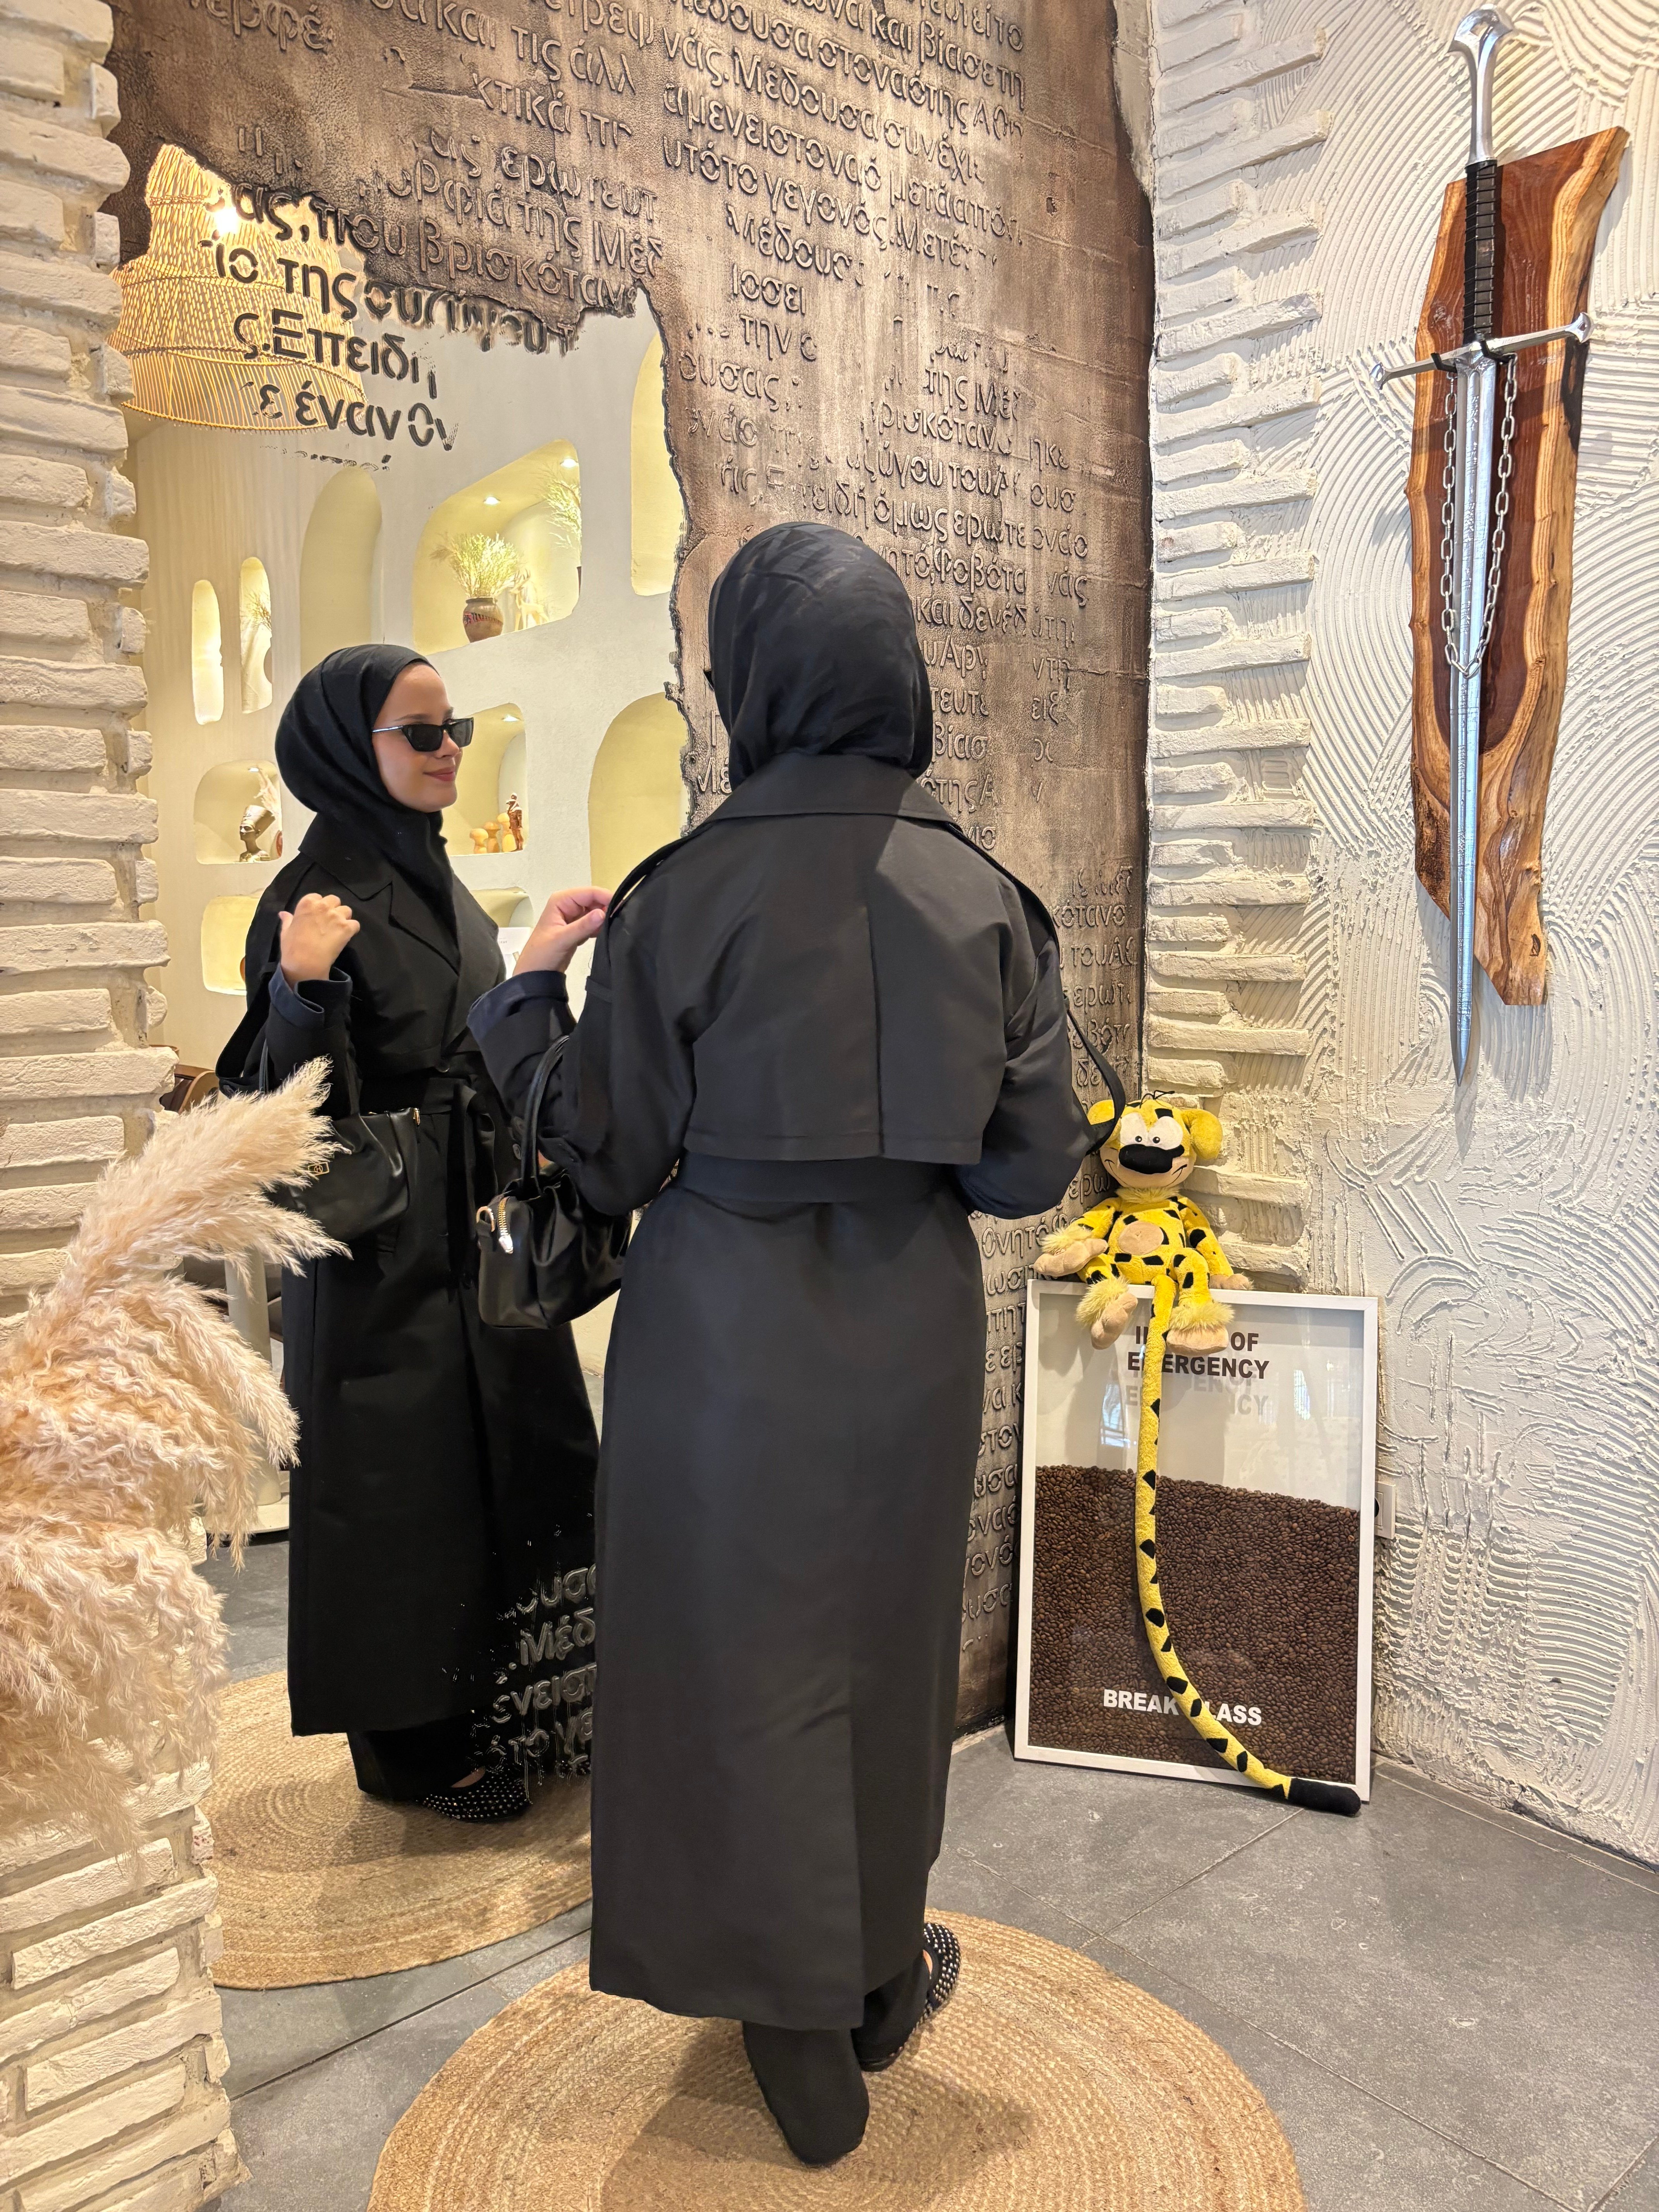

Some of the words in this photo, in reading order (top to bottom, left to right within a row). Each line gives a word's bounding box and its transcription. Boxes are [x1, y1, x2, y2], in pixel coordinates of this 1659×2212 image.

[1230, 1331, 1259, 1352] OF
[1128, 1351, 1270, 1379] EERGENCY
[1103, 1689, 1180, 1716] BREAK
